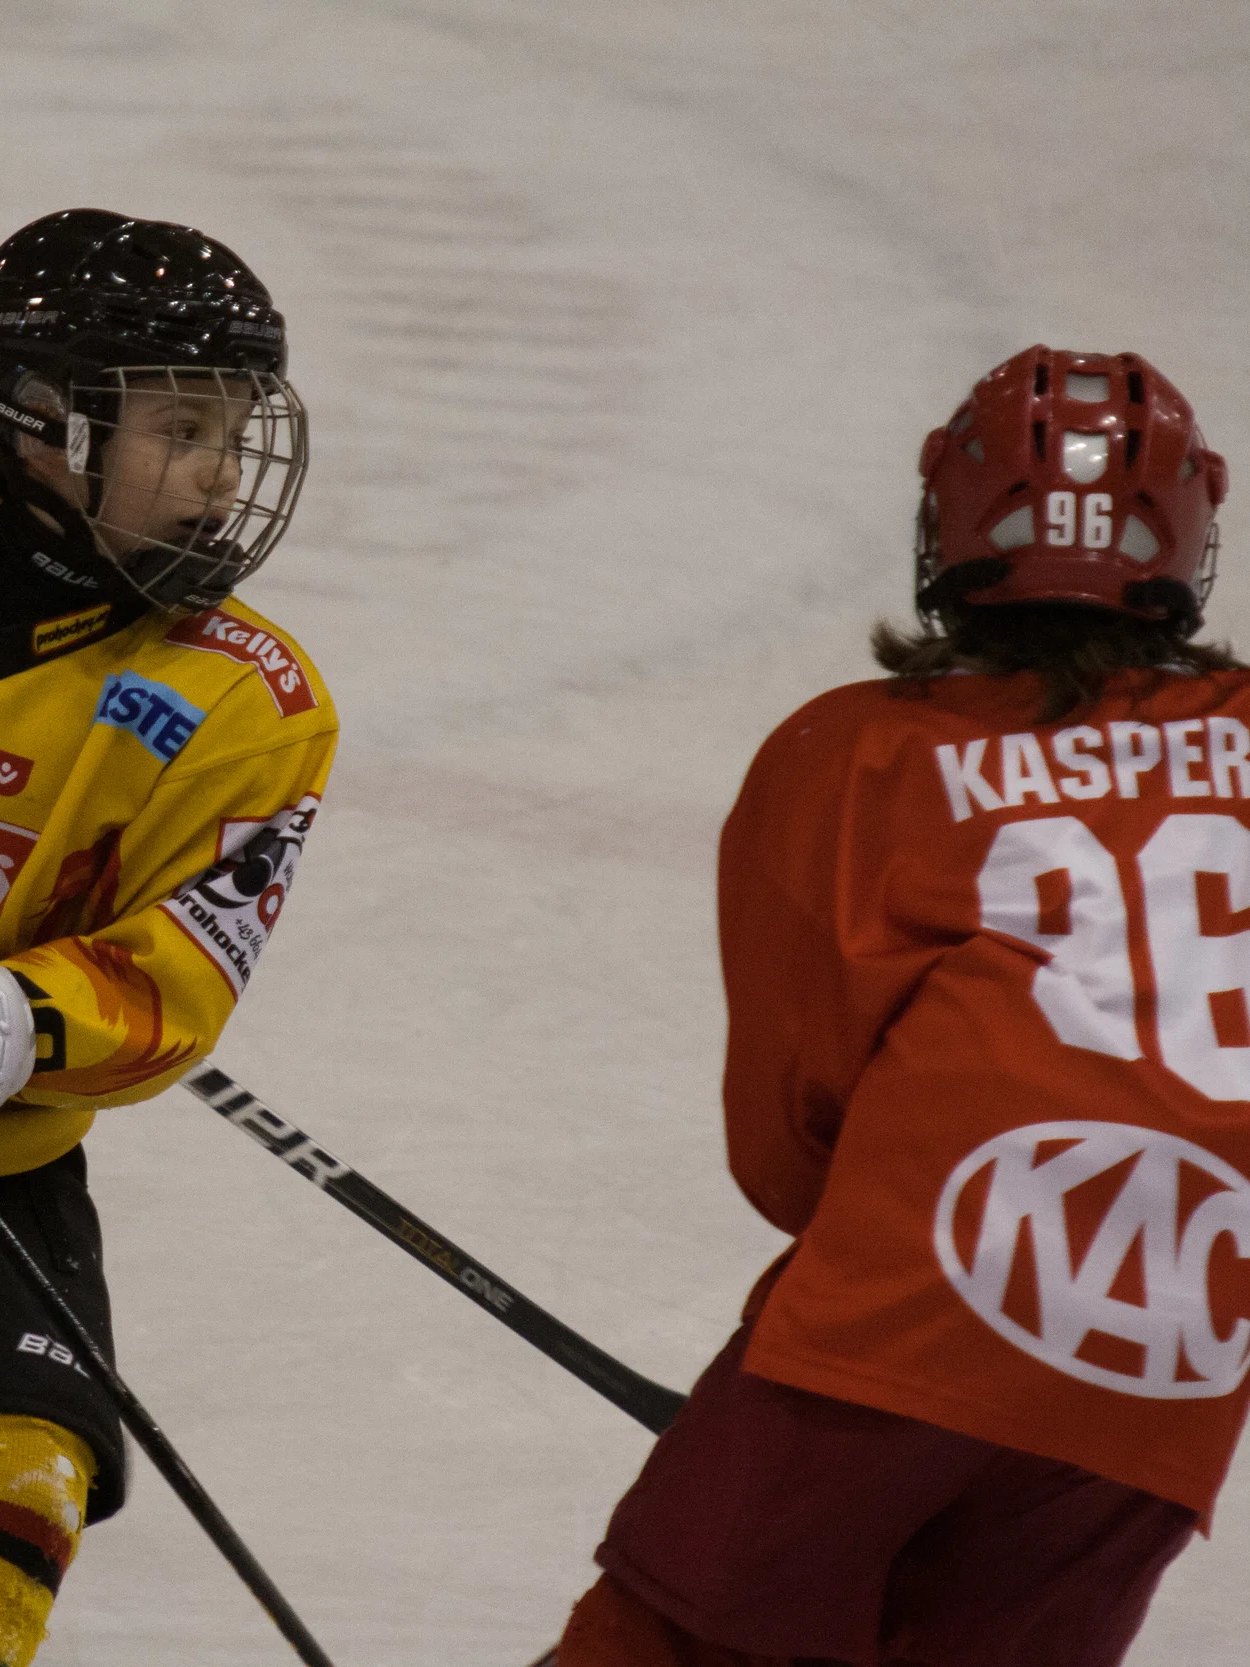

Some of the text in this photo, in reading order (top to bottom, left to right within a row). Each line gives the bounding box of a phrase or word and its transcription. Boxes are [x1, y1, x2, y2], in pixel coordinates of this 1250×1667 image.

[1046, 490, 1113, 549] 96
[202, 615, 301, 694] Kelly's
[976, 814, 1250, 1103] 96
